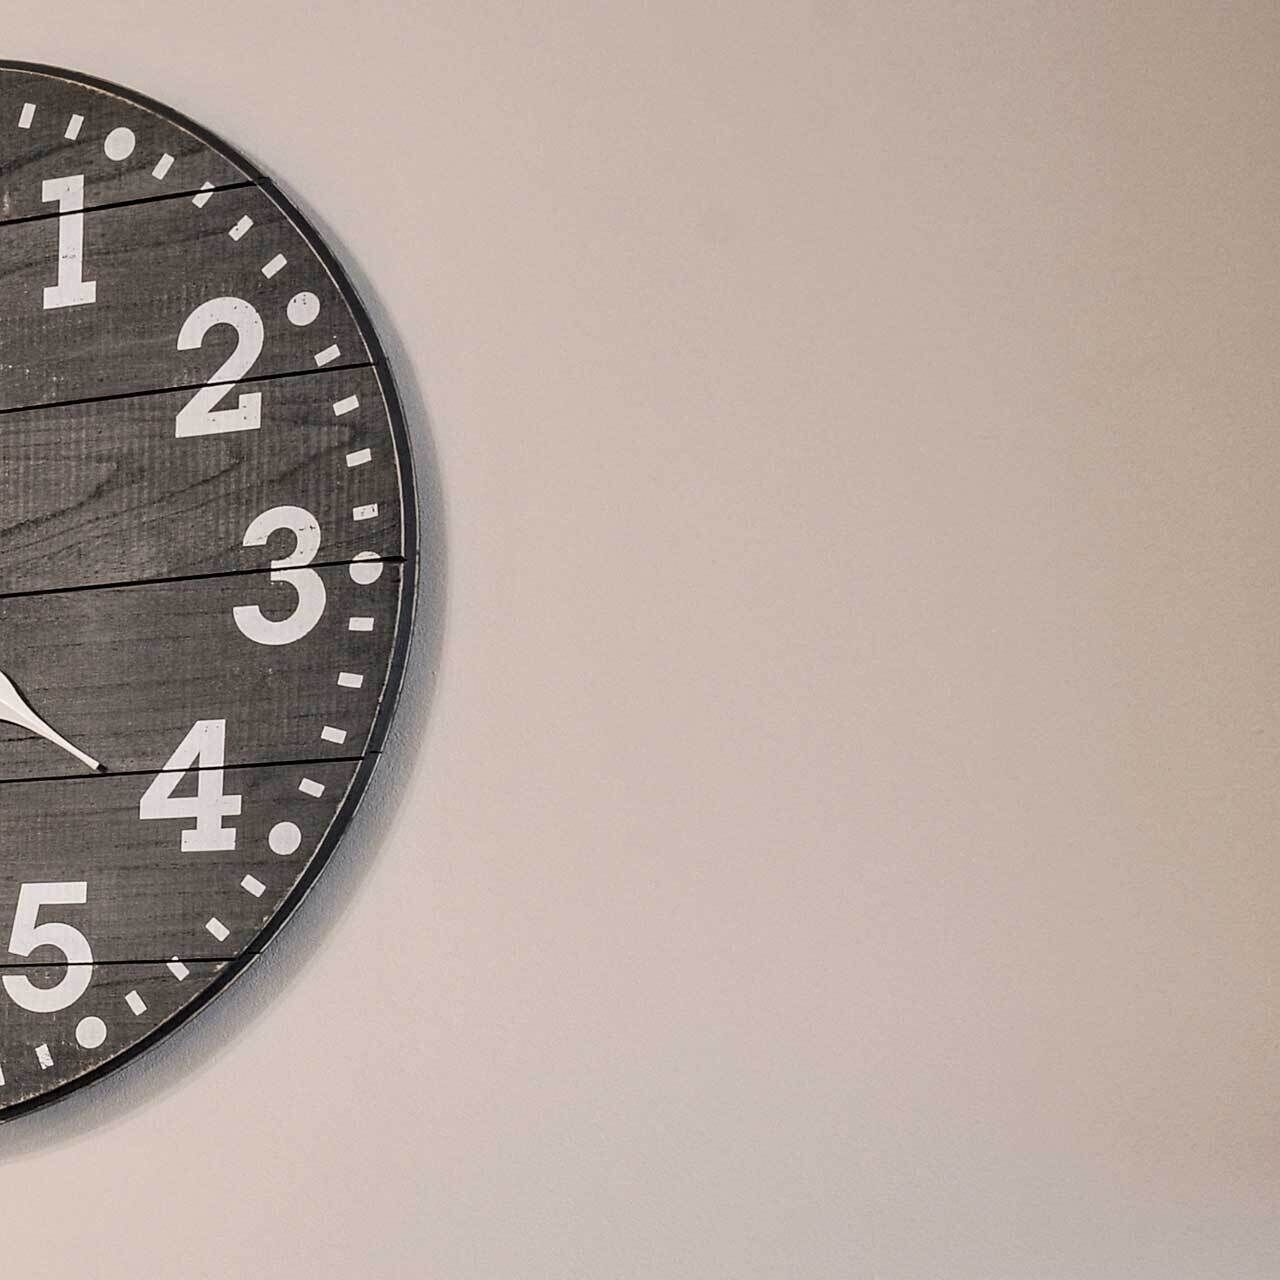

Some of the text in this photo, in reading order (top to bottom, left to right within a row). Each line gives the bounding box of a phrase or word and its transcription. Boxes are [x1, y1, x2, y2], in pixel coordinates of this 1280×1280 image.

[42, 175, 96, 309] 1
[175, 297, 264, 438] 2
[233, 506, 326, 645] 3
[140, 719, 241, 852] 4
[2, 882, 93, 1012] 5
